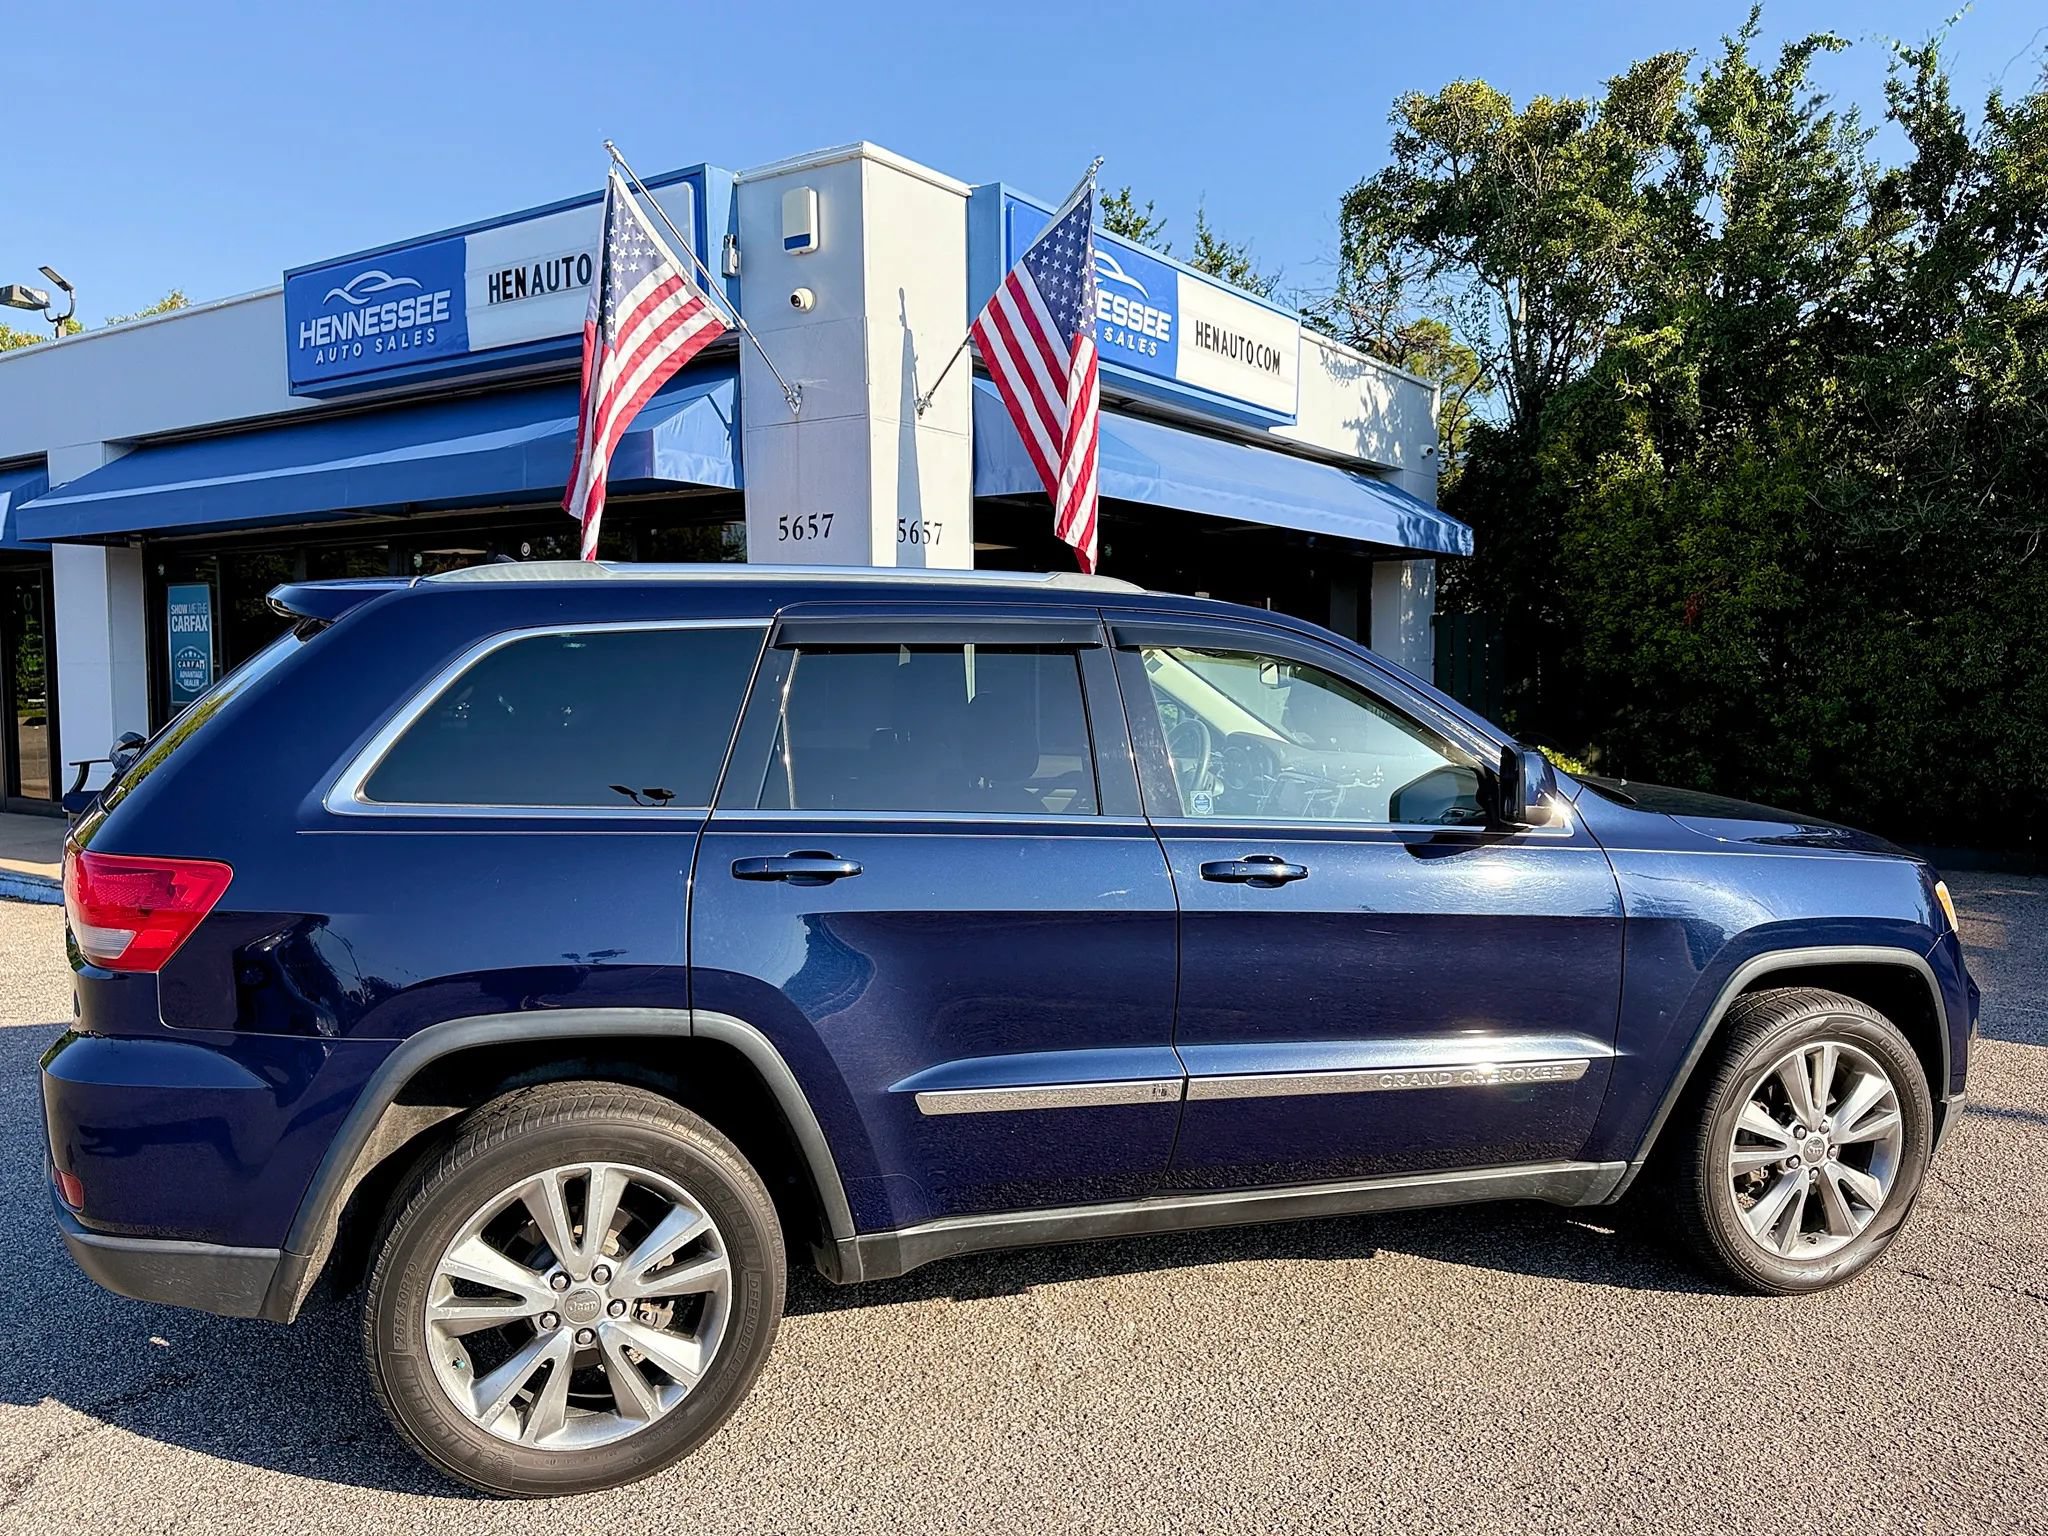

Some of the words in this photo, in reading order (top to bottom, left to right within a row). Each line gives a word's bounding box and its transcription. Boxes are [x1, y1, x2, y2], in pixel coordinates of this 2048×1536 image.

[488, 253, 592, 304] HENAUTO
[299, 289, 451, 349] HENNESSEE
[1096, 288, 1172, 343] ESSEE
[315, 342, 363, 365] AUTO
[375, 327, 436, 353] SALES
[1104, 326, 1158, 357] SALES
[1194, 319, 1282, 376] HENAUTO.COM
[778, 512, 835, 542] 5657
[896, 517, 943, 546] 5657
[171, 604, 188, 616] SHOW
[172, 615, 208, 632] CARFAX
[179, 670, 204, 679] ADVANTAGE
[183, 678, 200, 687] DEALER
[1379, 1072, 1452, 1089] GRAND
[1460, 1065, 1564, 1085] CHEROKEE
[394, 1262, 418, 1345] 265/50R20
